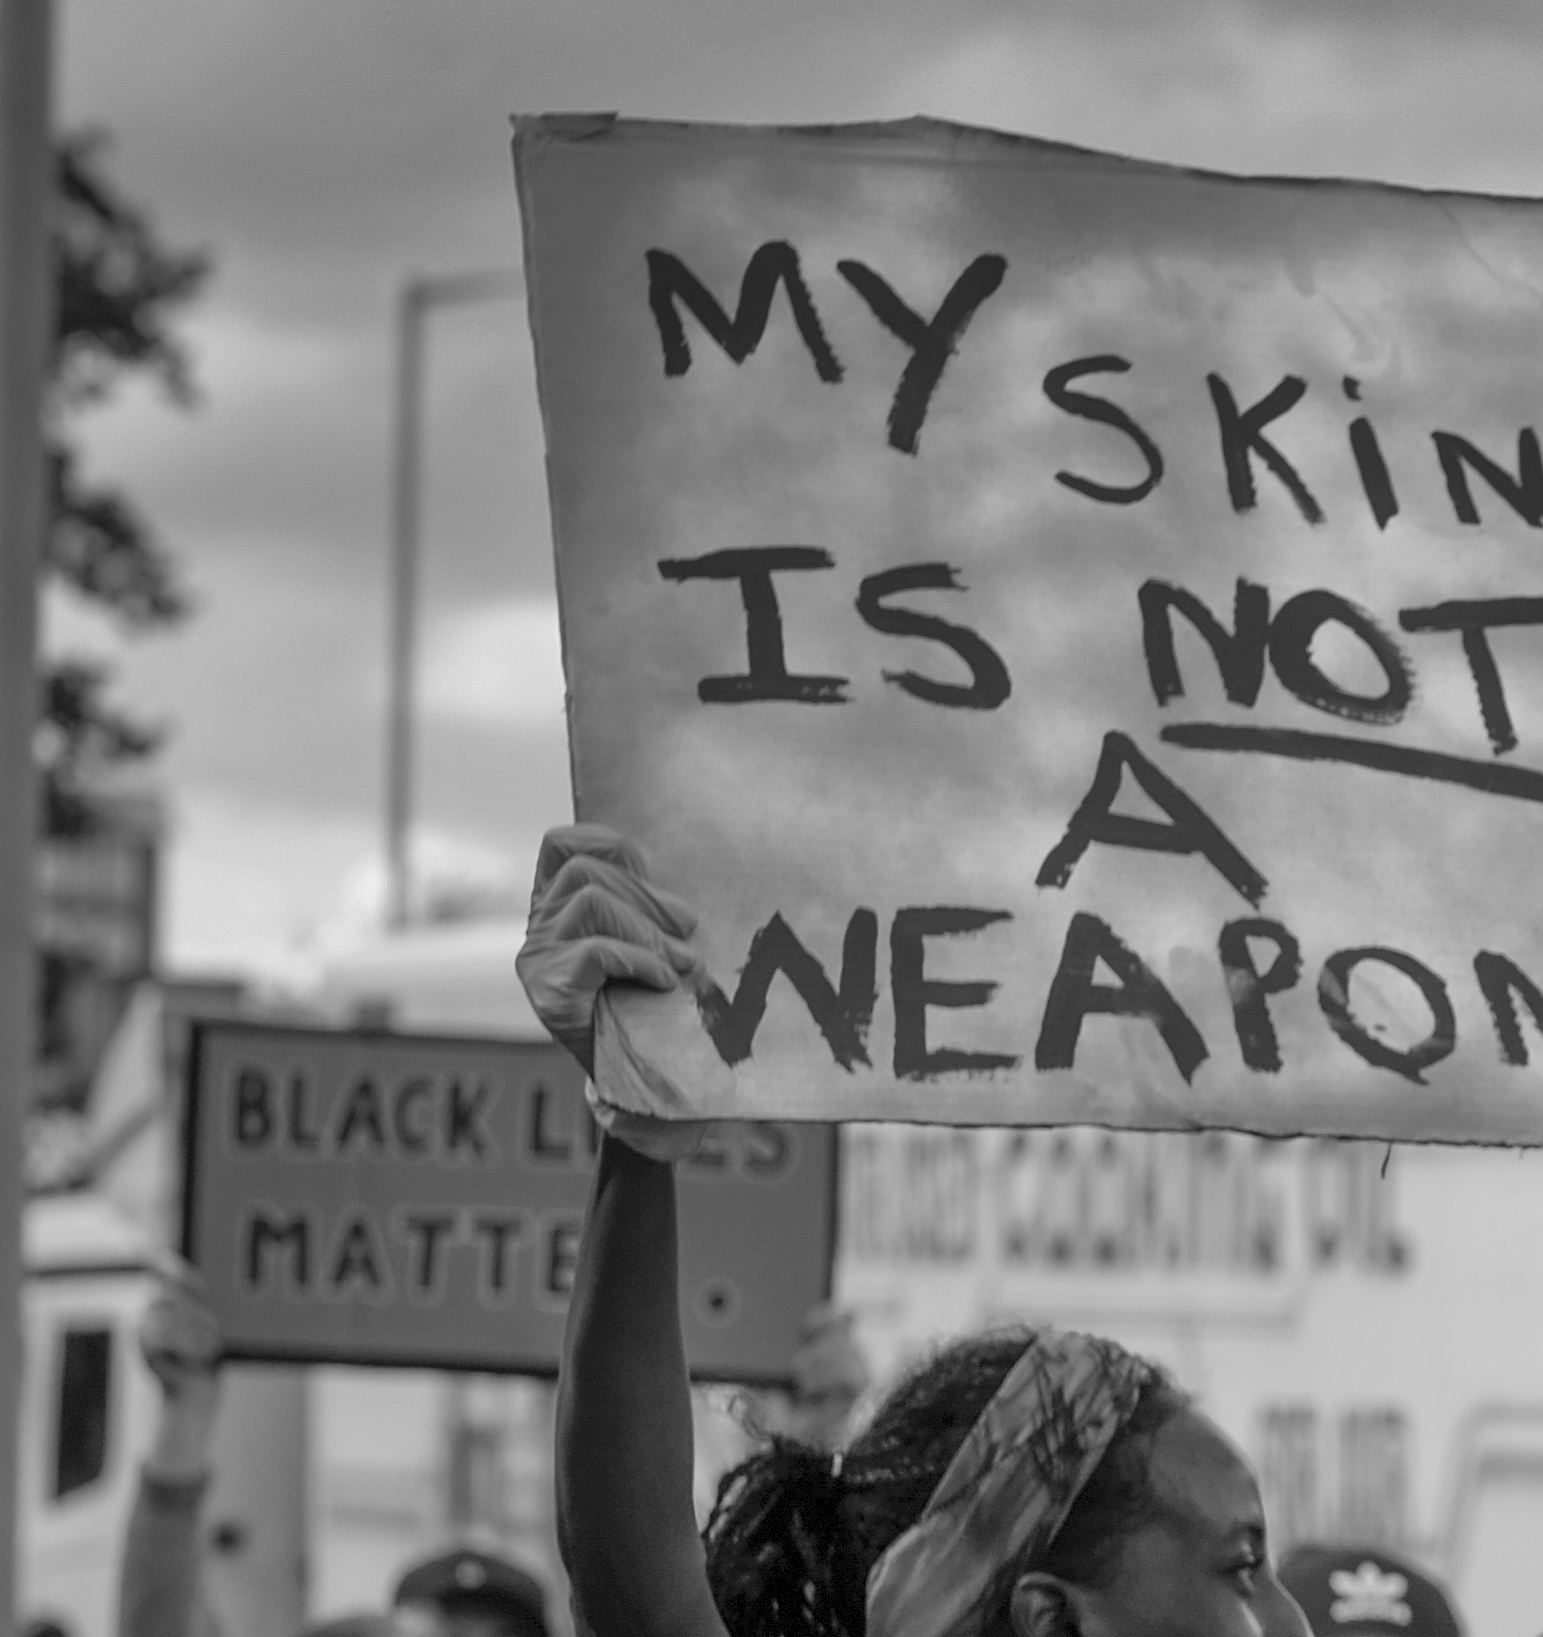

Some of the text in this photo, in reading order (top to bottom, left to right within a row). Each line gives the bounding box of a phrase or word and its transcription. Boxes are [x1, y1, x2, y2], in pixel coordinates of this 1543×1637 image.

[644, 241, 1008, 455] MY
[657, 546, 1014, 711] IS
[1036, 731, 1267, 907] A
[233, 1067, 490, 1156] BLACK
